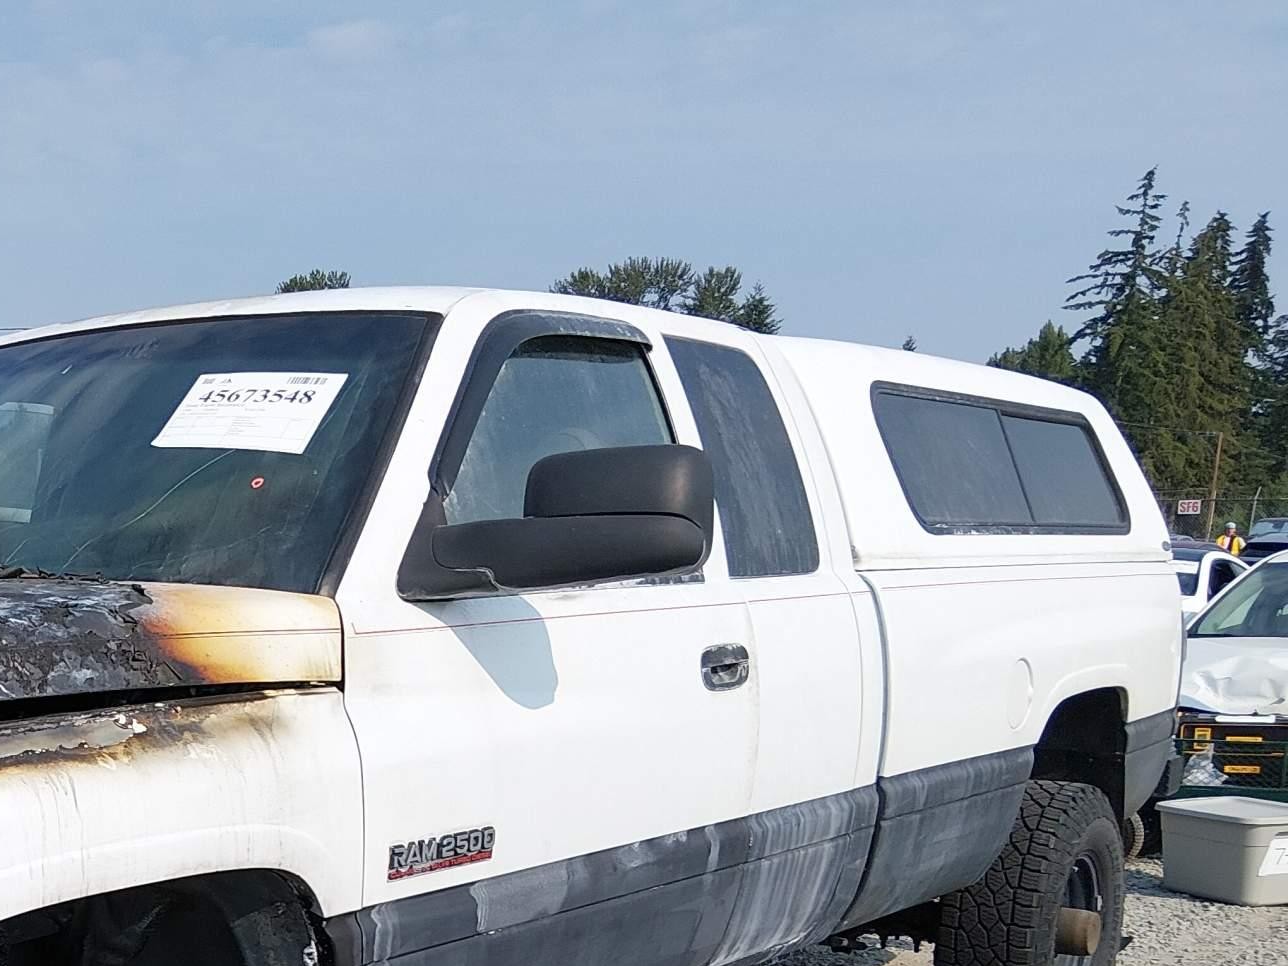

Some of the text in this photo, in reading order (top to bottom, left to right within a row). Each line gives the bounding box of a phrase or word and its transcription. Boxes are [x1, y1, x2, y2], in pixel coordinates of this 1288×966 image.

[199, 389, 316, 404] 45673548
[389, 837, 437, 870] RAM
[439, 826, 496, 859] 2500
